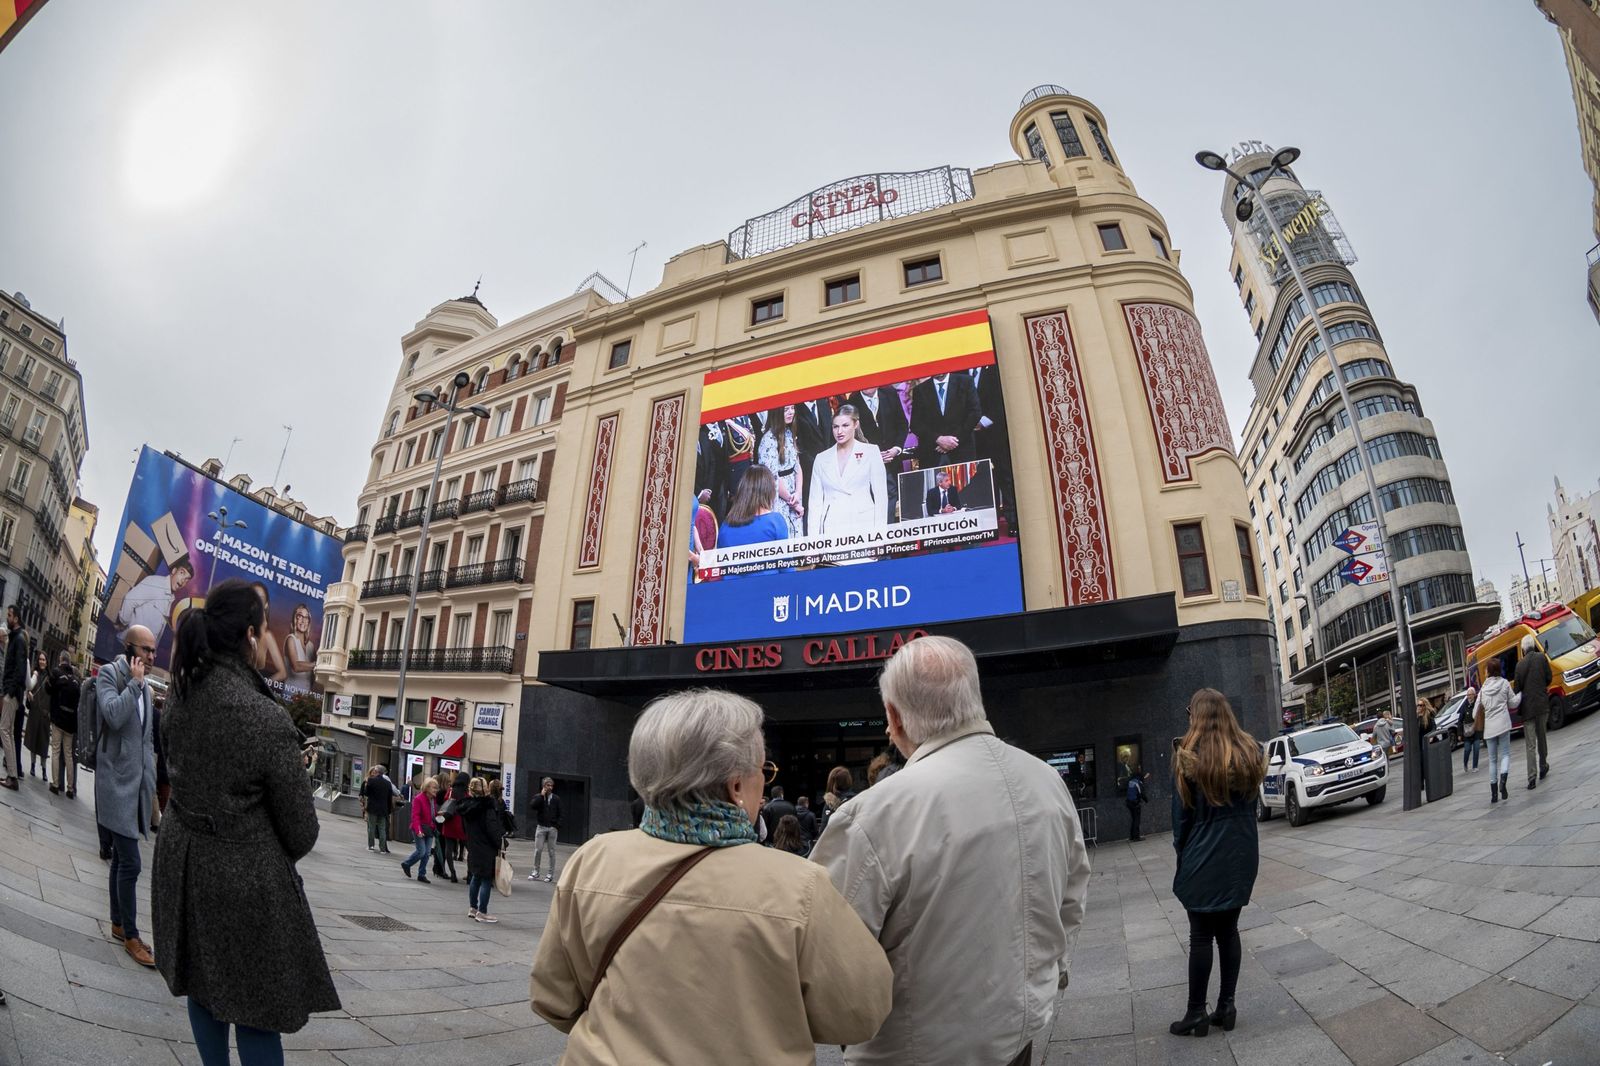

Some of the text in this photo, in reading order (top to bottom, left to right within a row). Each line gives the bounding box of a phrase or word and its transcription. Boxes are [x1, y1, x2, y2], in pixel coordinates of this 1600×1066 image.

[791, 188, 899, 228] CALLAO
[812, 181, 876, 208] CINES
[716, 517, 978, 563] LA PRINCESA LEONOR JURA LA CONSTITUCIÓN
[195, 538, 274, 581] OPERACIÓN
[213, 530, 322, 584] AMAZON TE TRAE
[727, 562, 765, 577] Majestades
[766, 561, 776, 569] los
[777, 559, 799, 570] Reyes
[800, 558, 805, 566] y
[806, 555, 820, 564] Sus
[821, 551, 849, 563] Altezas
[850, 548, 876, 559] Reales
[877, 546, 884, 555] la
[805, 585, 911, 617] MADRID
[695, 643, 783, 672] CINES
[273, 680, 284, 690] DE
[477, 716, 499, 726] CHANGE
[479, 707, 500, 717] CAMBIO
